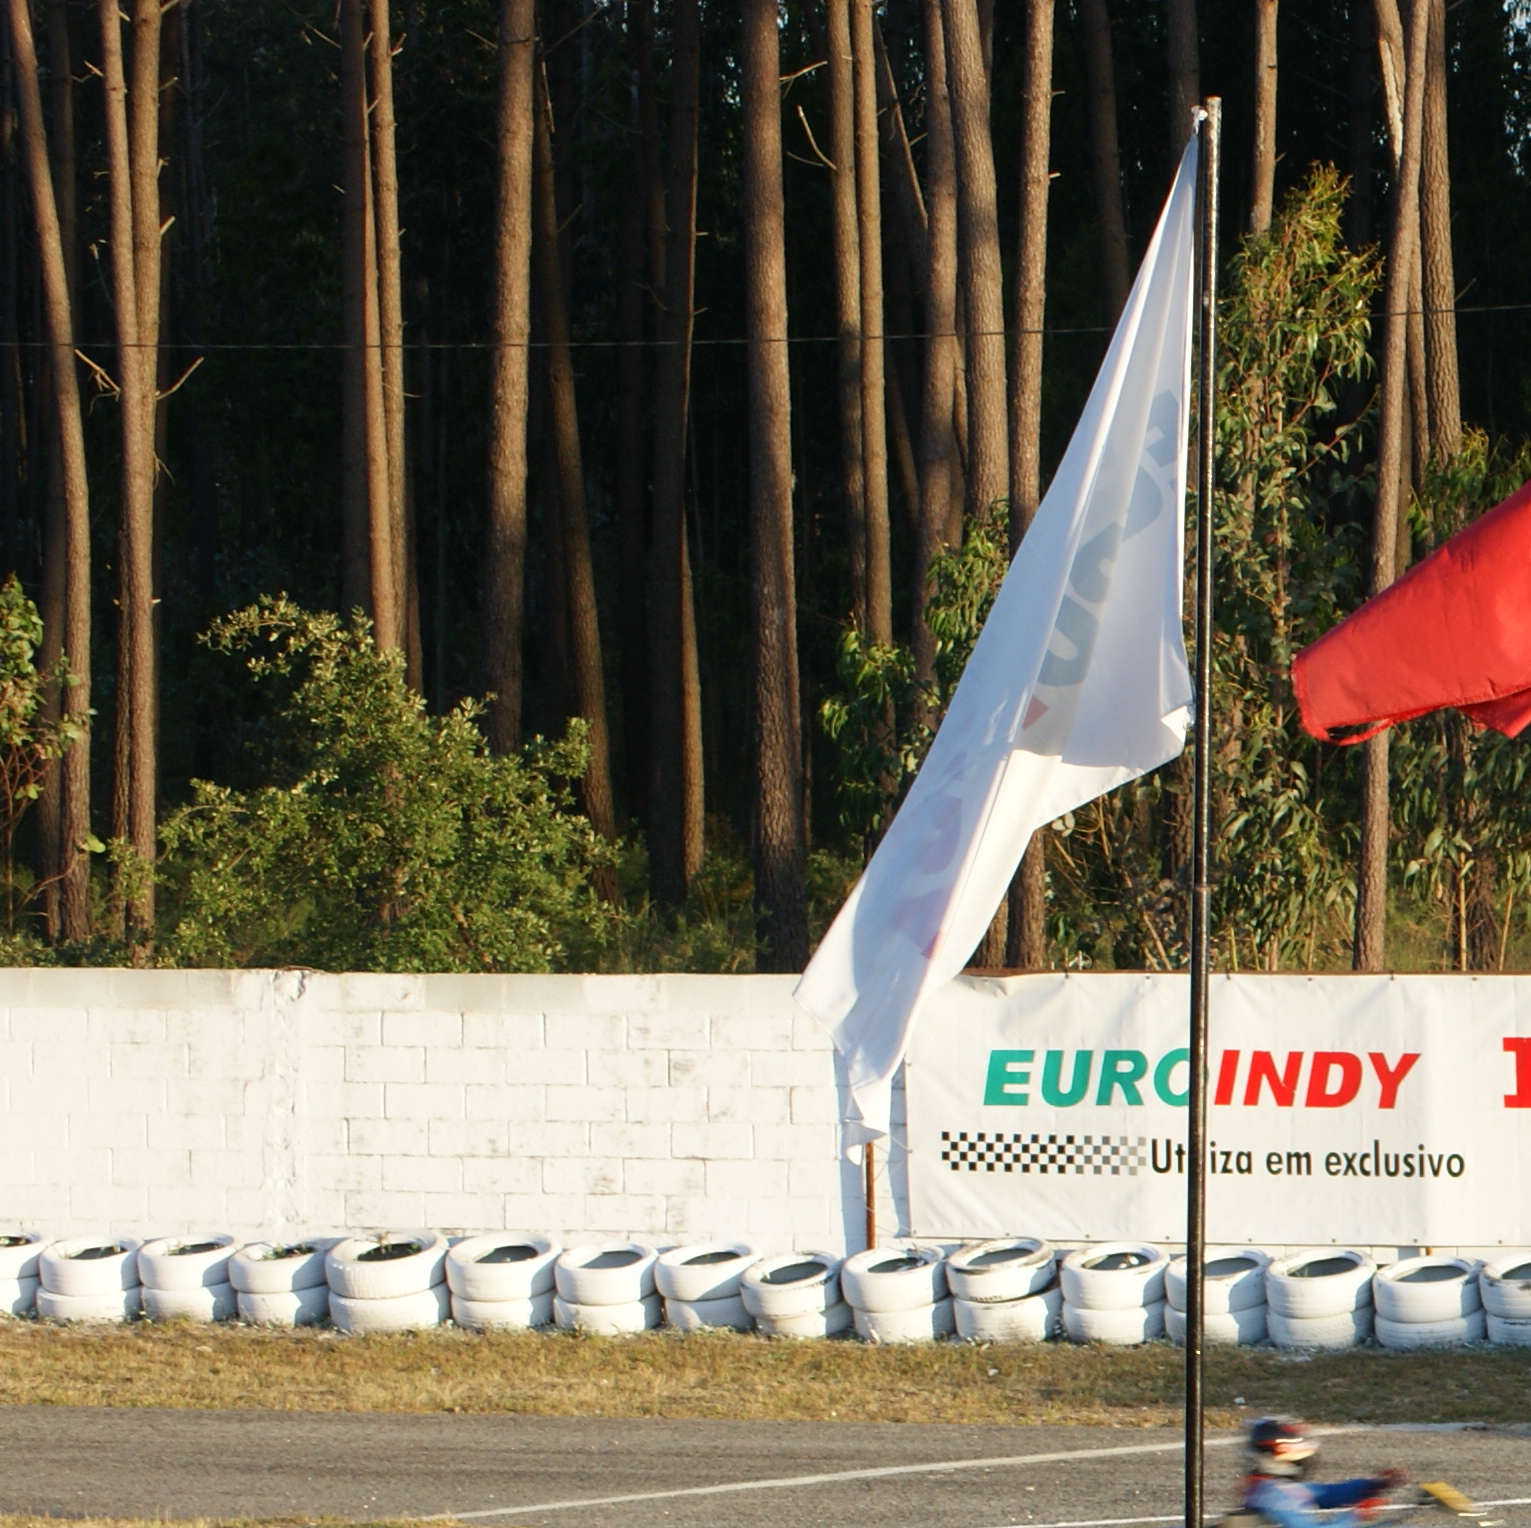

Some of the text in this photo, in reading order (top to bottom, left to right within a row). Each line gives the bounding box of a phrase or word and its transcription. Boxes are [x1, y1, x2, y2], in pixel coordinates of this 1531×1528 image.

[982, 1048, 1421, 1110] EUROINDY
[1150, 1137, 1466, 1178] Utiza em exclusivo
